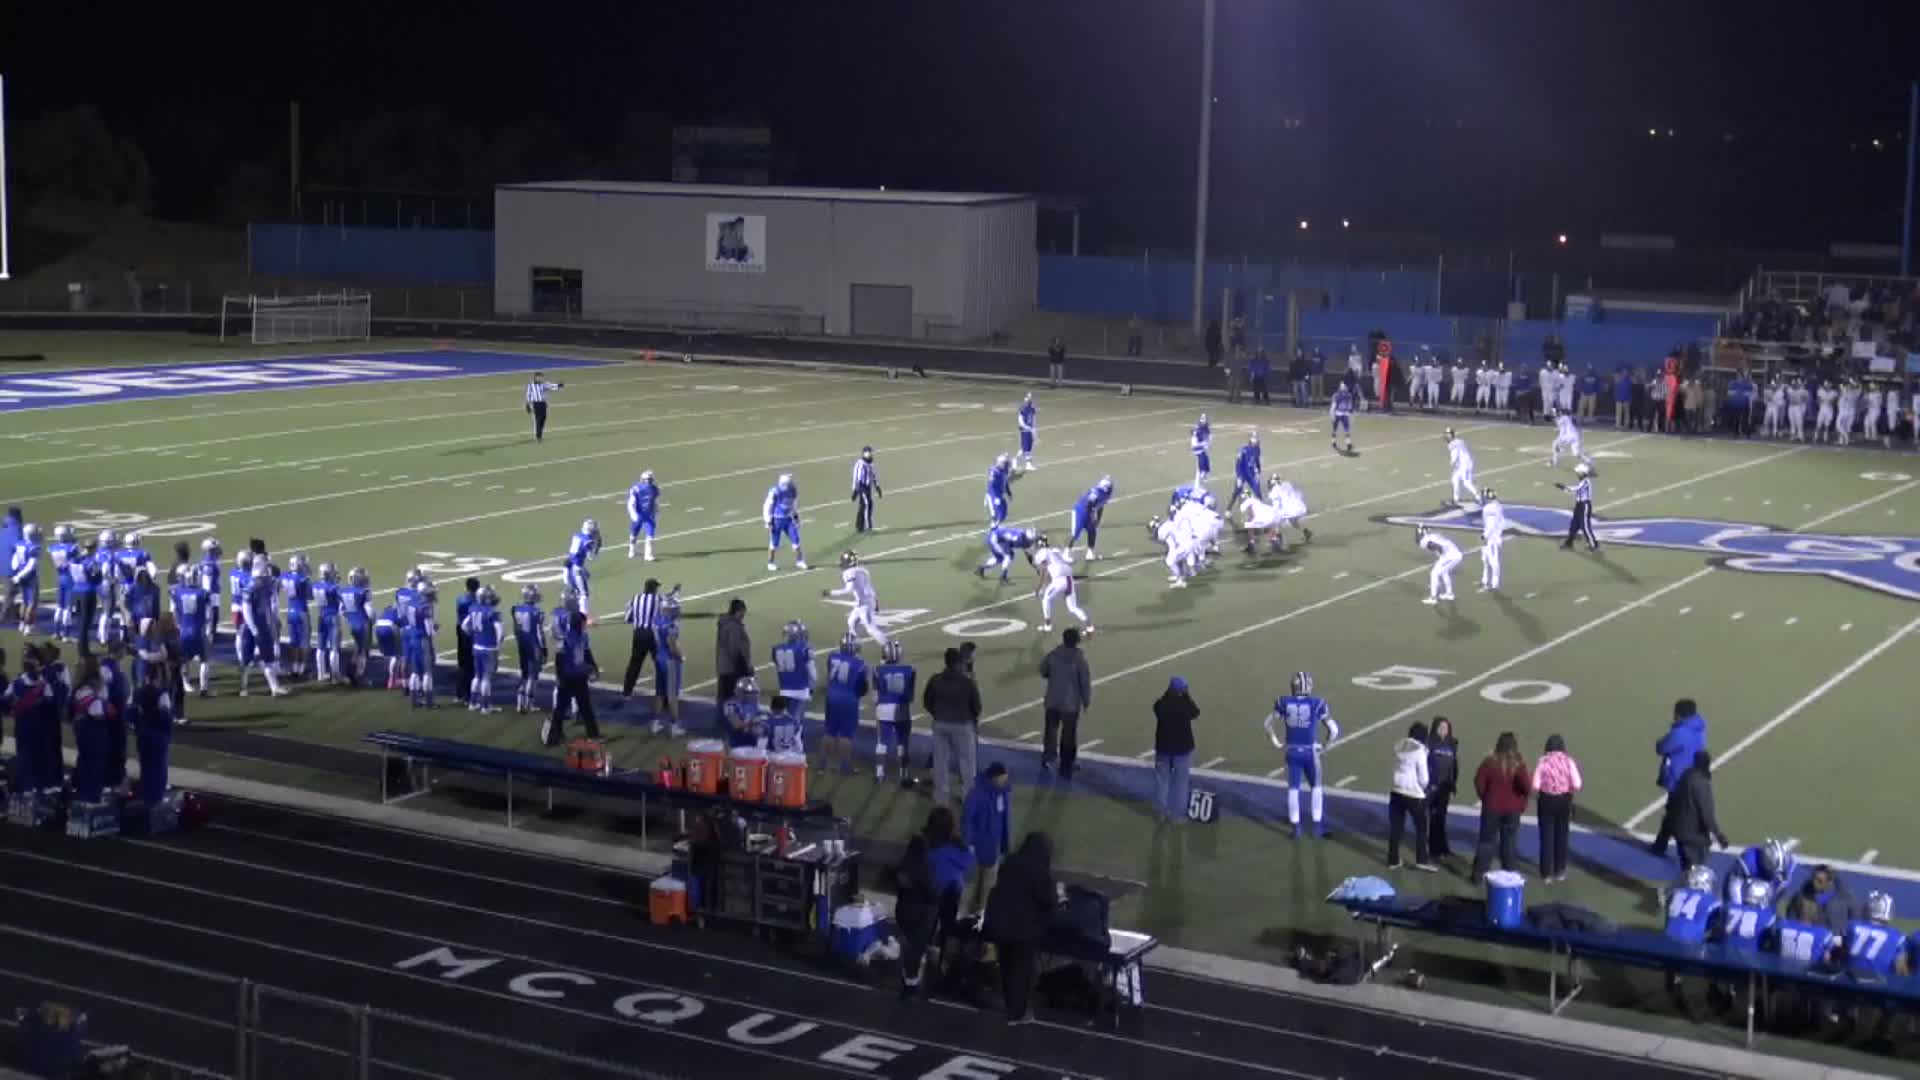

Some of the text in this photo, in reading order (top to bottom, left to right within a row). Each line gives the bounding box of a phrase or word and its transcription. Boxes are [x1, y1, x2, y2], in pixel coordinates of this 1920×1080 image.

[0, 359, 463, 402] UEEN
[1351, 664, 1572, 704] 50
[1188, 790, 1213, 821] 50
[1850, 925, 1888, 960] 77
